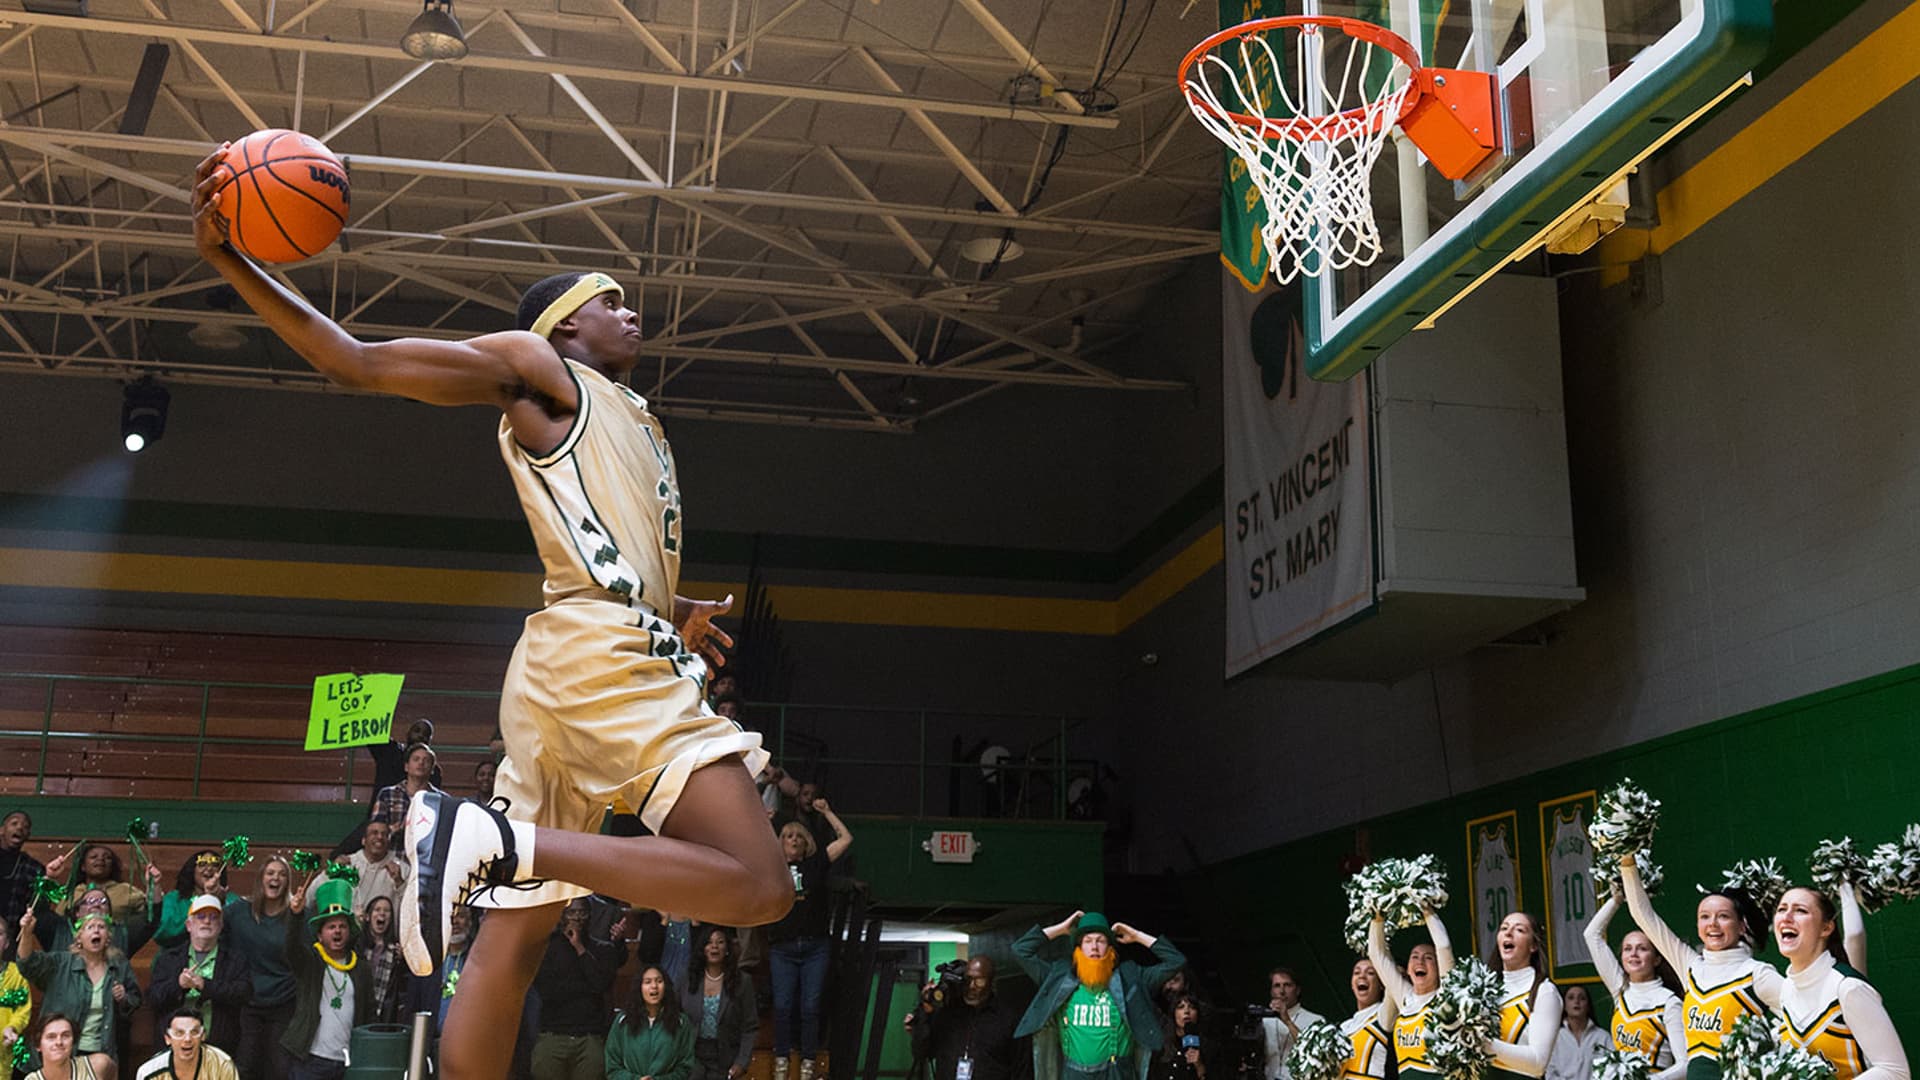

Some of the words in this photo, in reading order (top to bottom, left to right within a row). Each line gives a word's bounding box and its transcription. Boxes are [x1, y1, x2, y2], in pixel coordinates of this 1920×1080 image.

[1236, 488, 1264, 543] ST.
[1269, 416, 1354, 521] VINCENT
[1250, 547, 1280, 600] ST.
[1286, 502, 1342, 583] MARY
[328, 679, 364, 701] LETS
[322, 712, 391, 745] LEBRON
[941, 832, 969, 854] EXIT
[1486, 886, 1509, 932] 30
[1563, 871, 1585, 922] 10
[1073, 1004, 1111, 1027] IRISH
[1687, 1006, 1723, 1032] Irish
[1615, 1024, 1642, 1049] Irish
